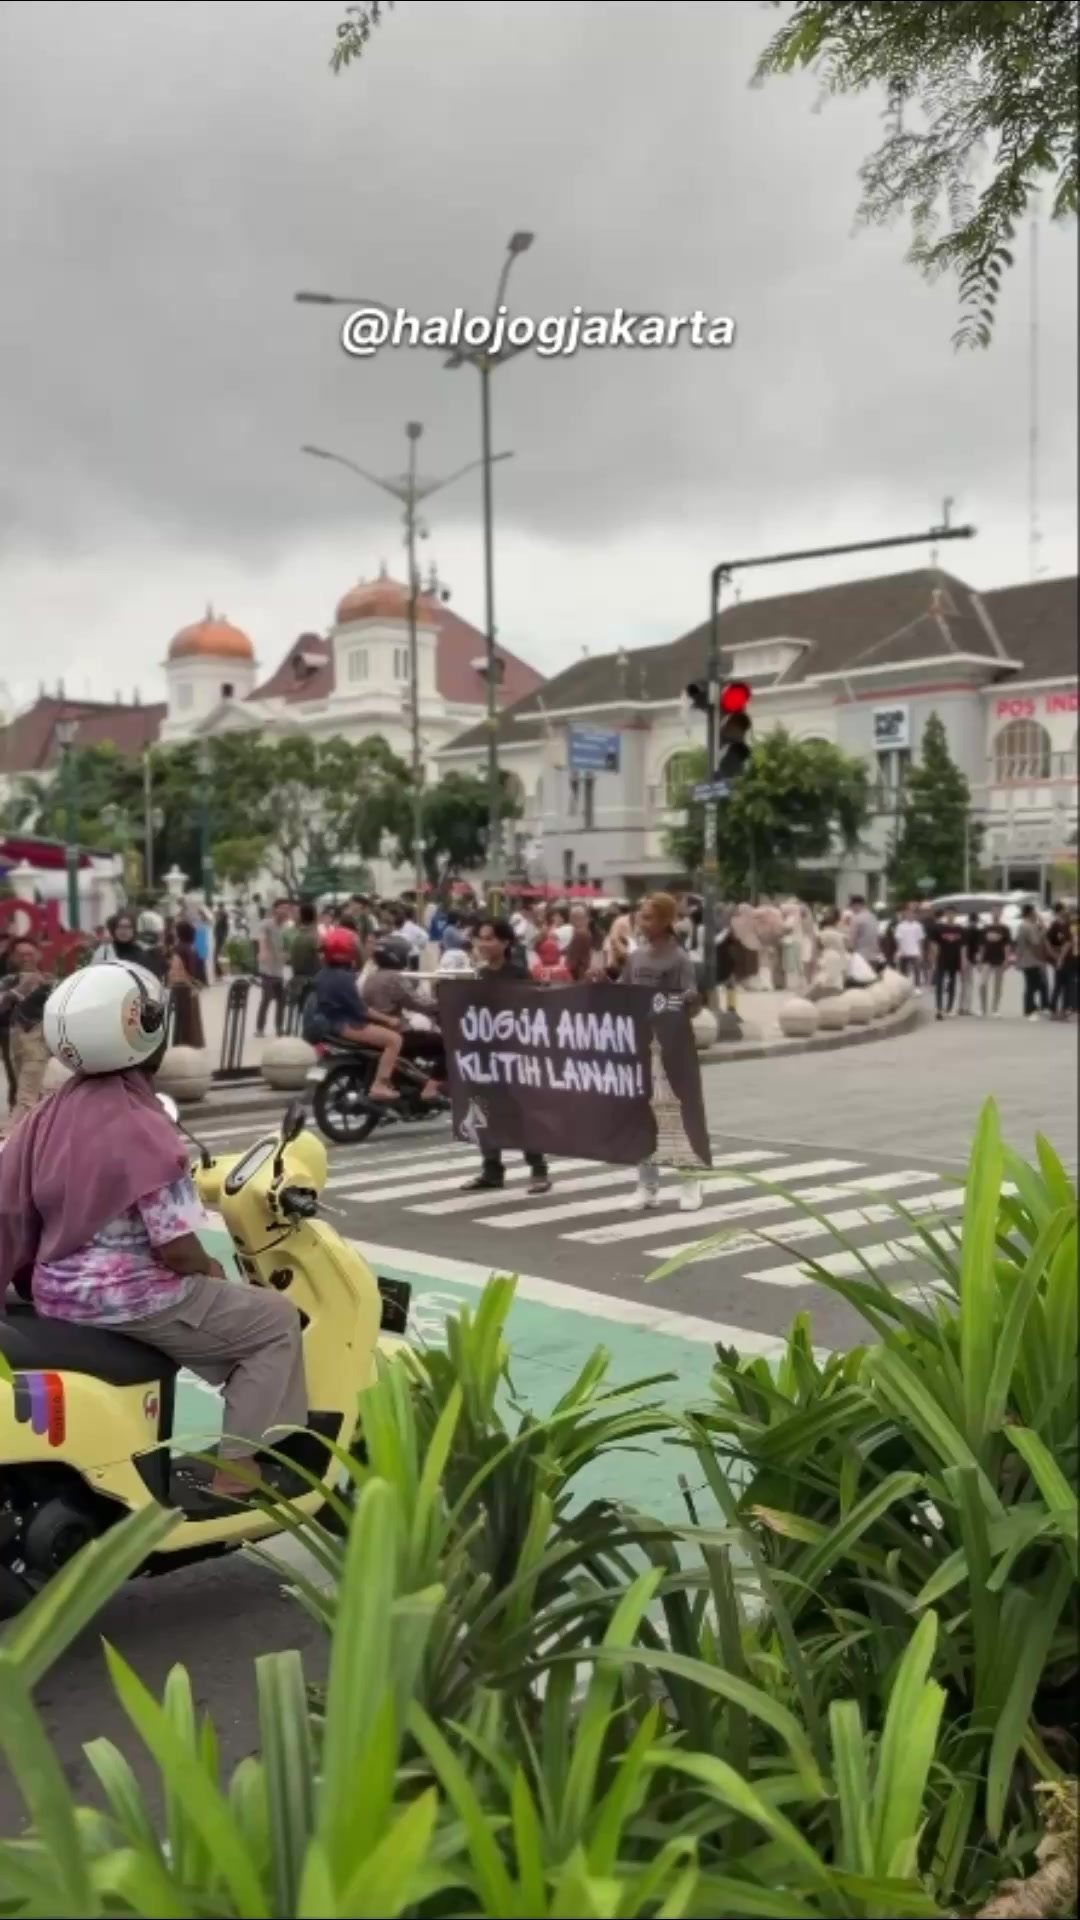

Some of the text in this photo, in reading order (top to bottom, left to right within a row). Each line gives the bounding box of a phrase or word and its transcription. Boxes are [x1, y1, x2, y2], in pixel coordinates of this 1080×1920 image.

[996, 698, 1035, 717] POS
[460, 1005, 637, 1055] JOGJA AMAN
[455, 1050, 645, 1098] KLITIH LAWAN!
